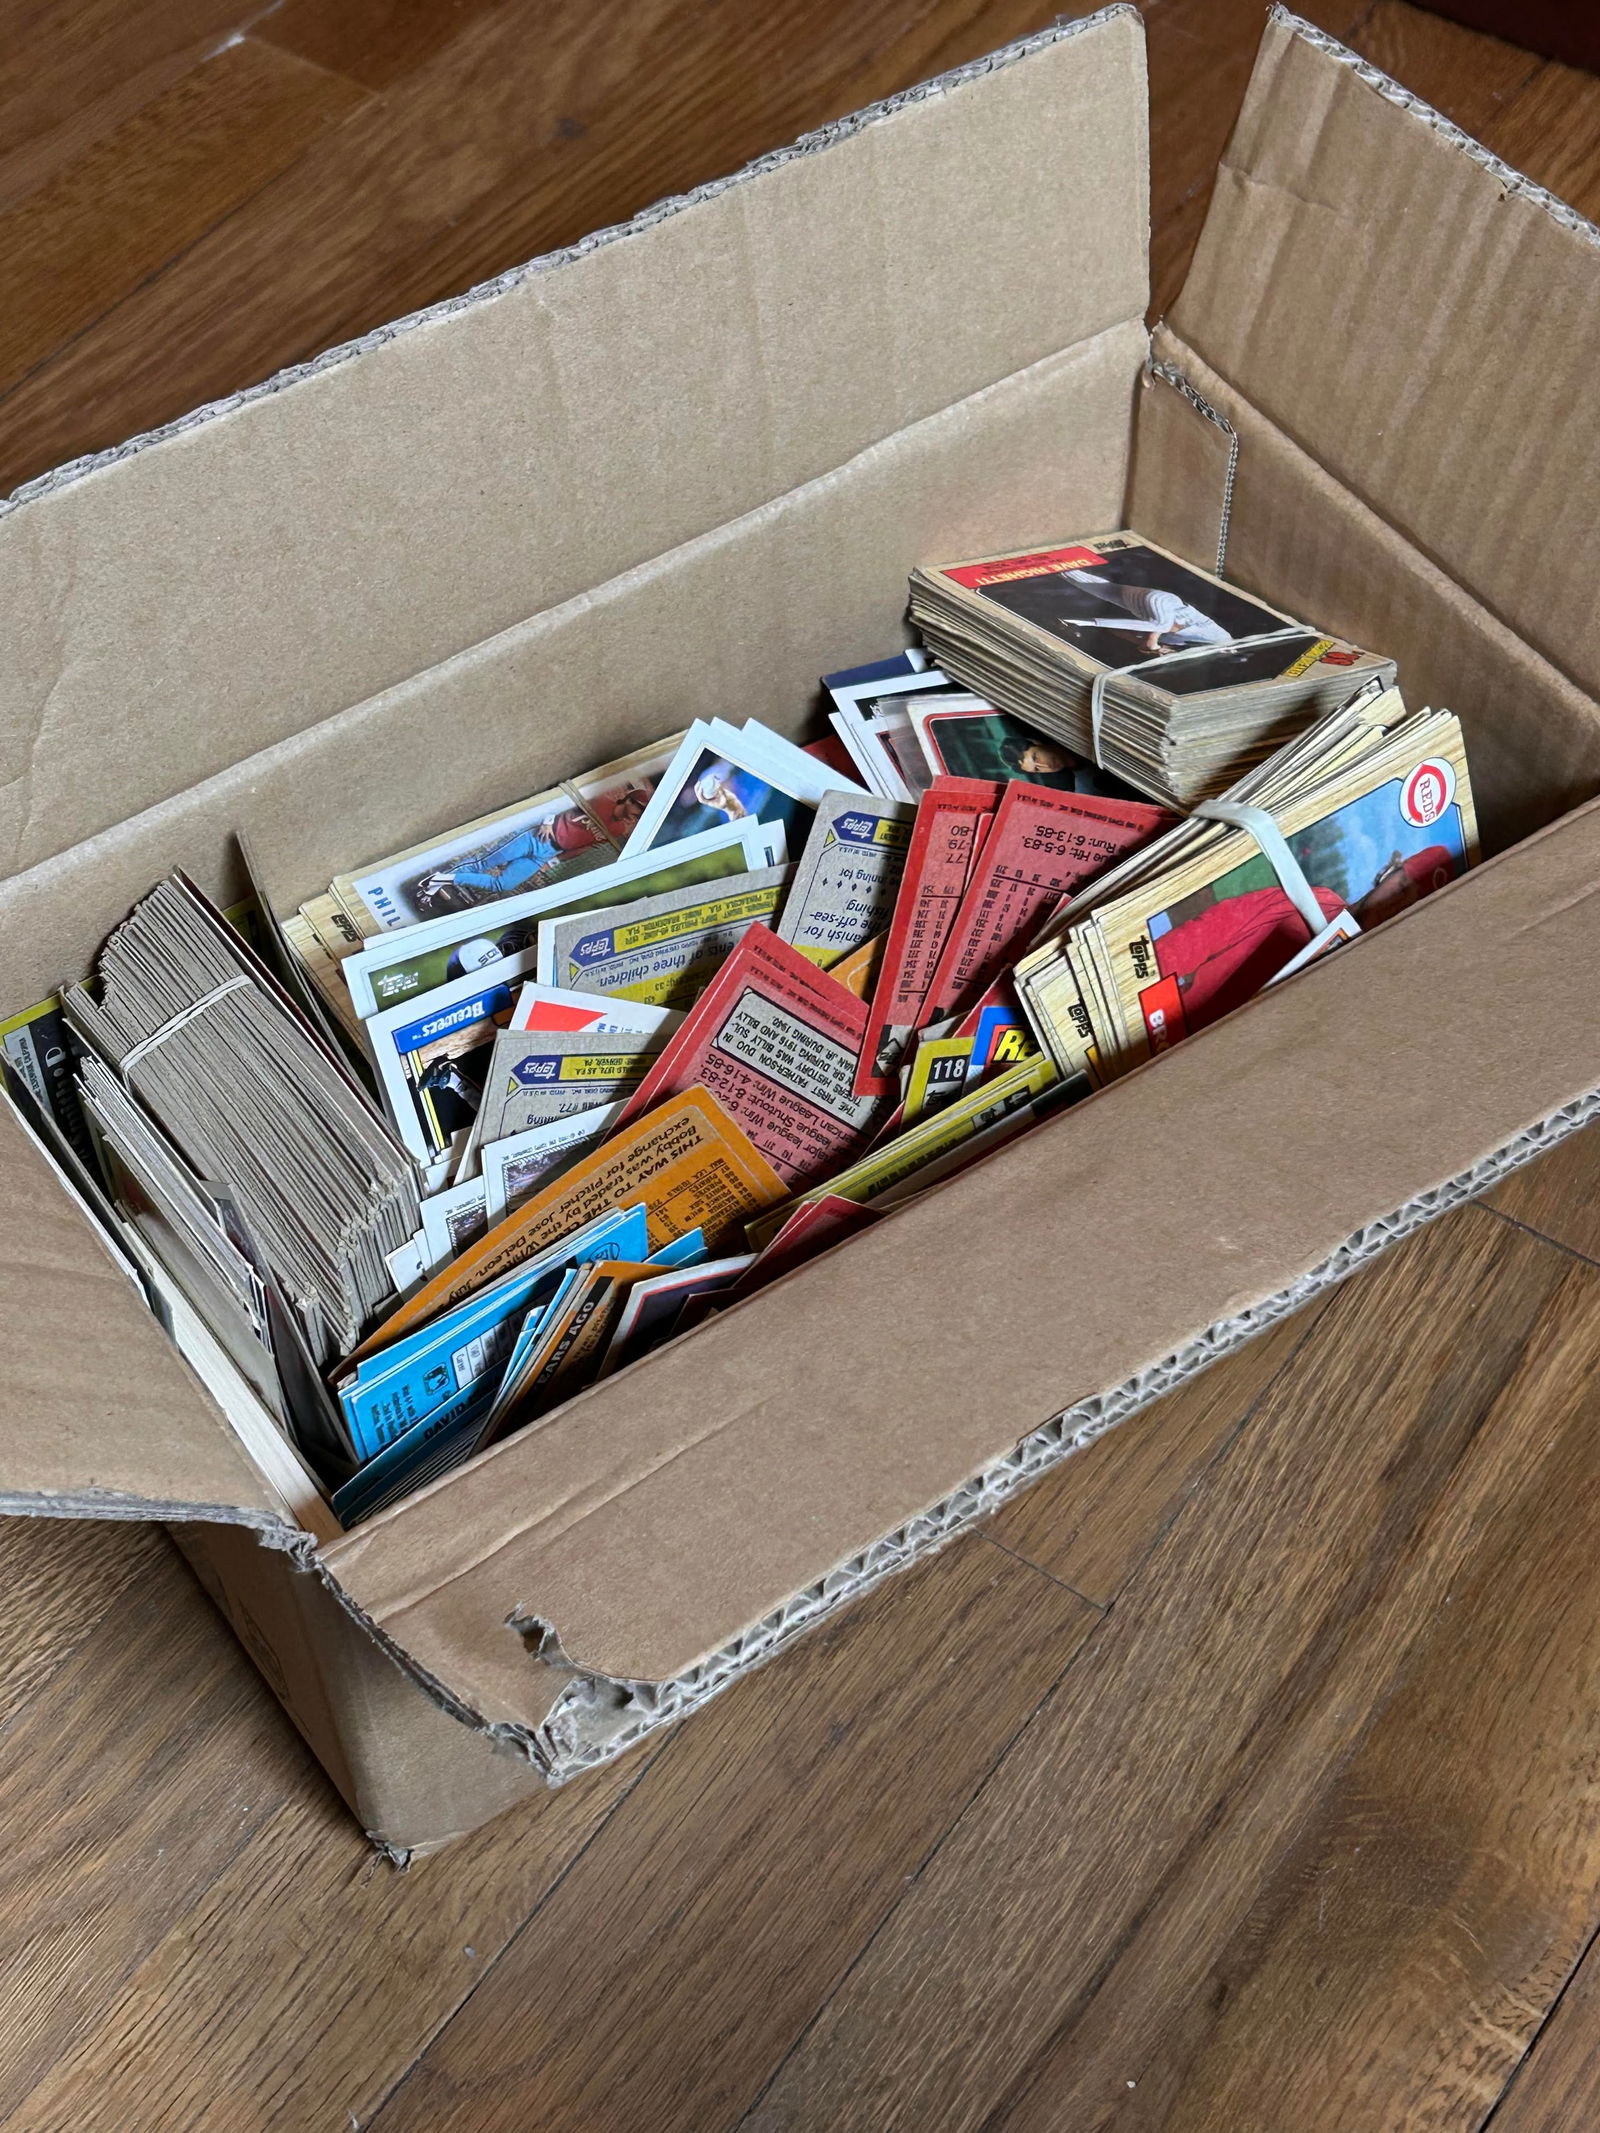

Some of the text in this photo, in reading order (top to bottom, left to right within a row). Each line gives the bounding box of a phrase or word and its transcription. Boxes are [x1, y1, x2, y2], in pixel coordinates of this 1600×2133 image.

[1048, 557, 1091, 573] DAVE
[1414, 776, 1440, 822] REDS
[367, 882, 404, 933] PHIL
[802, 923, 824, 940] for
[651, 954, 688, 974] three
[417, 1000, 487, 1038] Brewers
[725, 1019, 751, 1041] SUL-
[733, 1008, 761, 1031] BILLY
[758, 1022, 780, 1041] AND
[789, 1026, 826, 1054] DURING
[733, 1038, 757, 1058] DUO
[747, 1033, 775, 1056] BILLY
[821, 1046, 839, 1064] JR.
[772, 1047, 795, 1068] WAS
[796, 1045, 833, 1073] DURING
[933, 1058, 965, 1079] 118
[755, 1051, 811, 1090] FATHER-SON
[792, 1060, 833, 1090] HISTORY
[829, 1064, 848, 1083] SR.
[810, 1083, 837, 1106] FIRST
[776, 1092, 822, 1126] League
[836, 1098, 858, 1118] THE
[621, 1114, 694, 1164] exchange
[650, 1121, 700, 1157] Bobby
[600, 1157, 628, 1181] for
[623, 1151, 656, 1177] was
[578, 1131, 705, 1224] THIS WAY TO THE
[579, 1169, 625, 1209] traded
[559, 1201, 583, 1223] by
[537, 1218, 563, 1242] the
[536, 1336, 573, 1386] EARS
[566, 1298, 597, 1338] AGO
